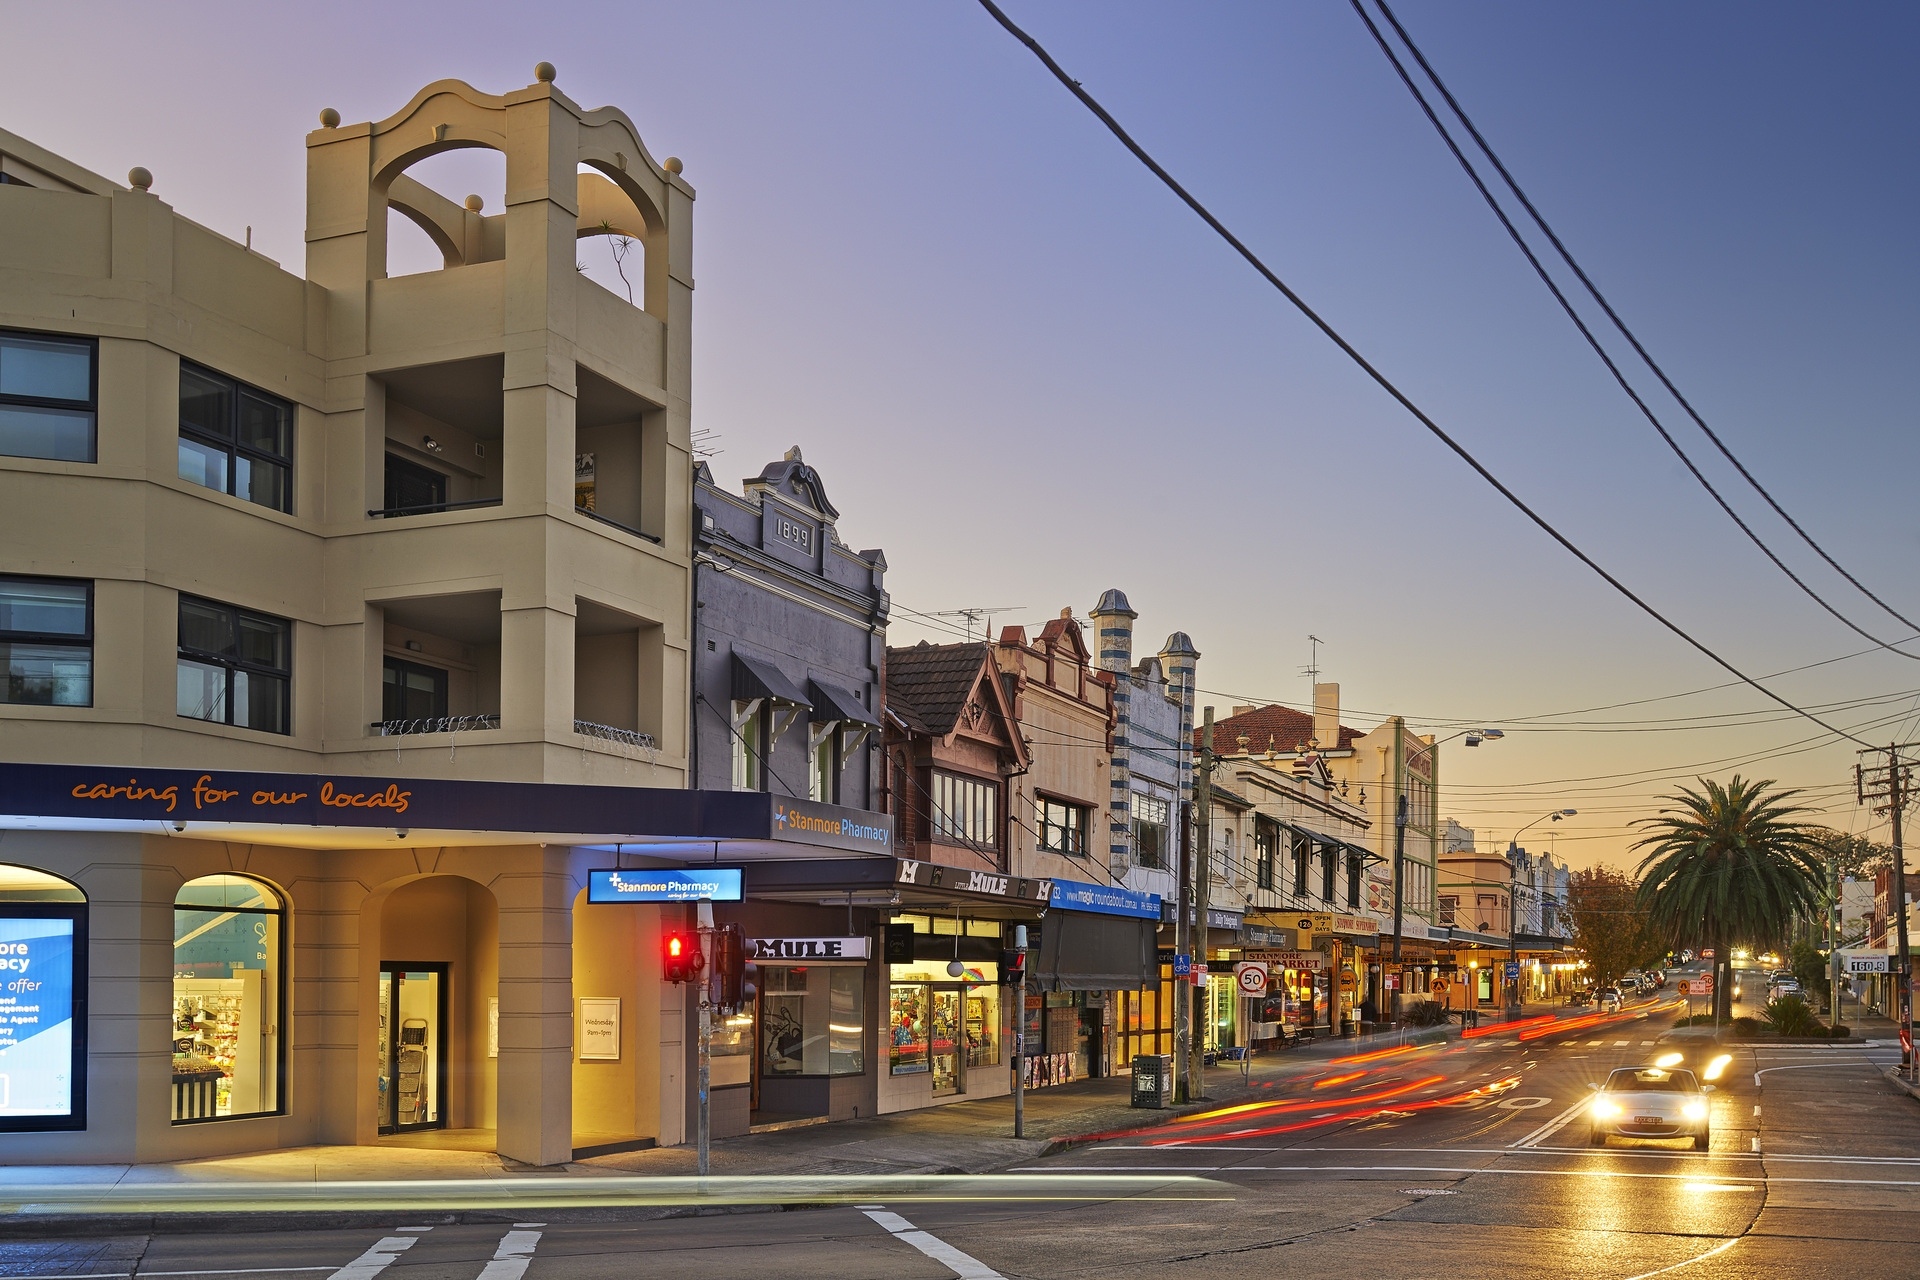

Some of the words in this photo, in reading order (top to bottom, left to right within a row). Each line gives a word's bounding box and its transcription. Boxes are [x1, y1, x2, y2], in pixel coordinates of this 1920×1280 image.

[777, 518, 807, 546] 1899
[71, 778, 178, 812] caring
[192, 774, 239, 809] for
[252, 789, 307, 805] our
[320, 781, 412, 813] locals
[789, 809, 840, 835] Stanmore
[841, 818, 889, 846] Pharmacy
[617, 881, 667, 893] Stanmore
[667, 881, 719, 893] Pharmacy
[968, 871, 1008, 895] MULE
[1299, 919, 1312, 929] 126
[1250, 927, 1269, 942] Stanmore
[1268, 929, 1287, 946] Pharmacy
[755, 939, 842, 957] MULE
[1248, 952, 1303, 960] STANMORE
[1852, 962, 1884, 971] 160.9
[8, 978, 42, 994] offer
[1244, 974, 1261, 985] 50
[10, 1015, 39, 1025] Agent
[584, 1018, 615, 1027] Wednesday
